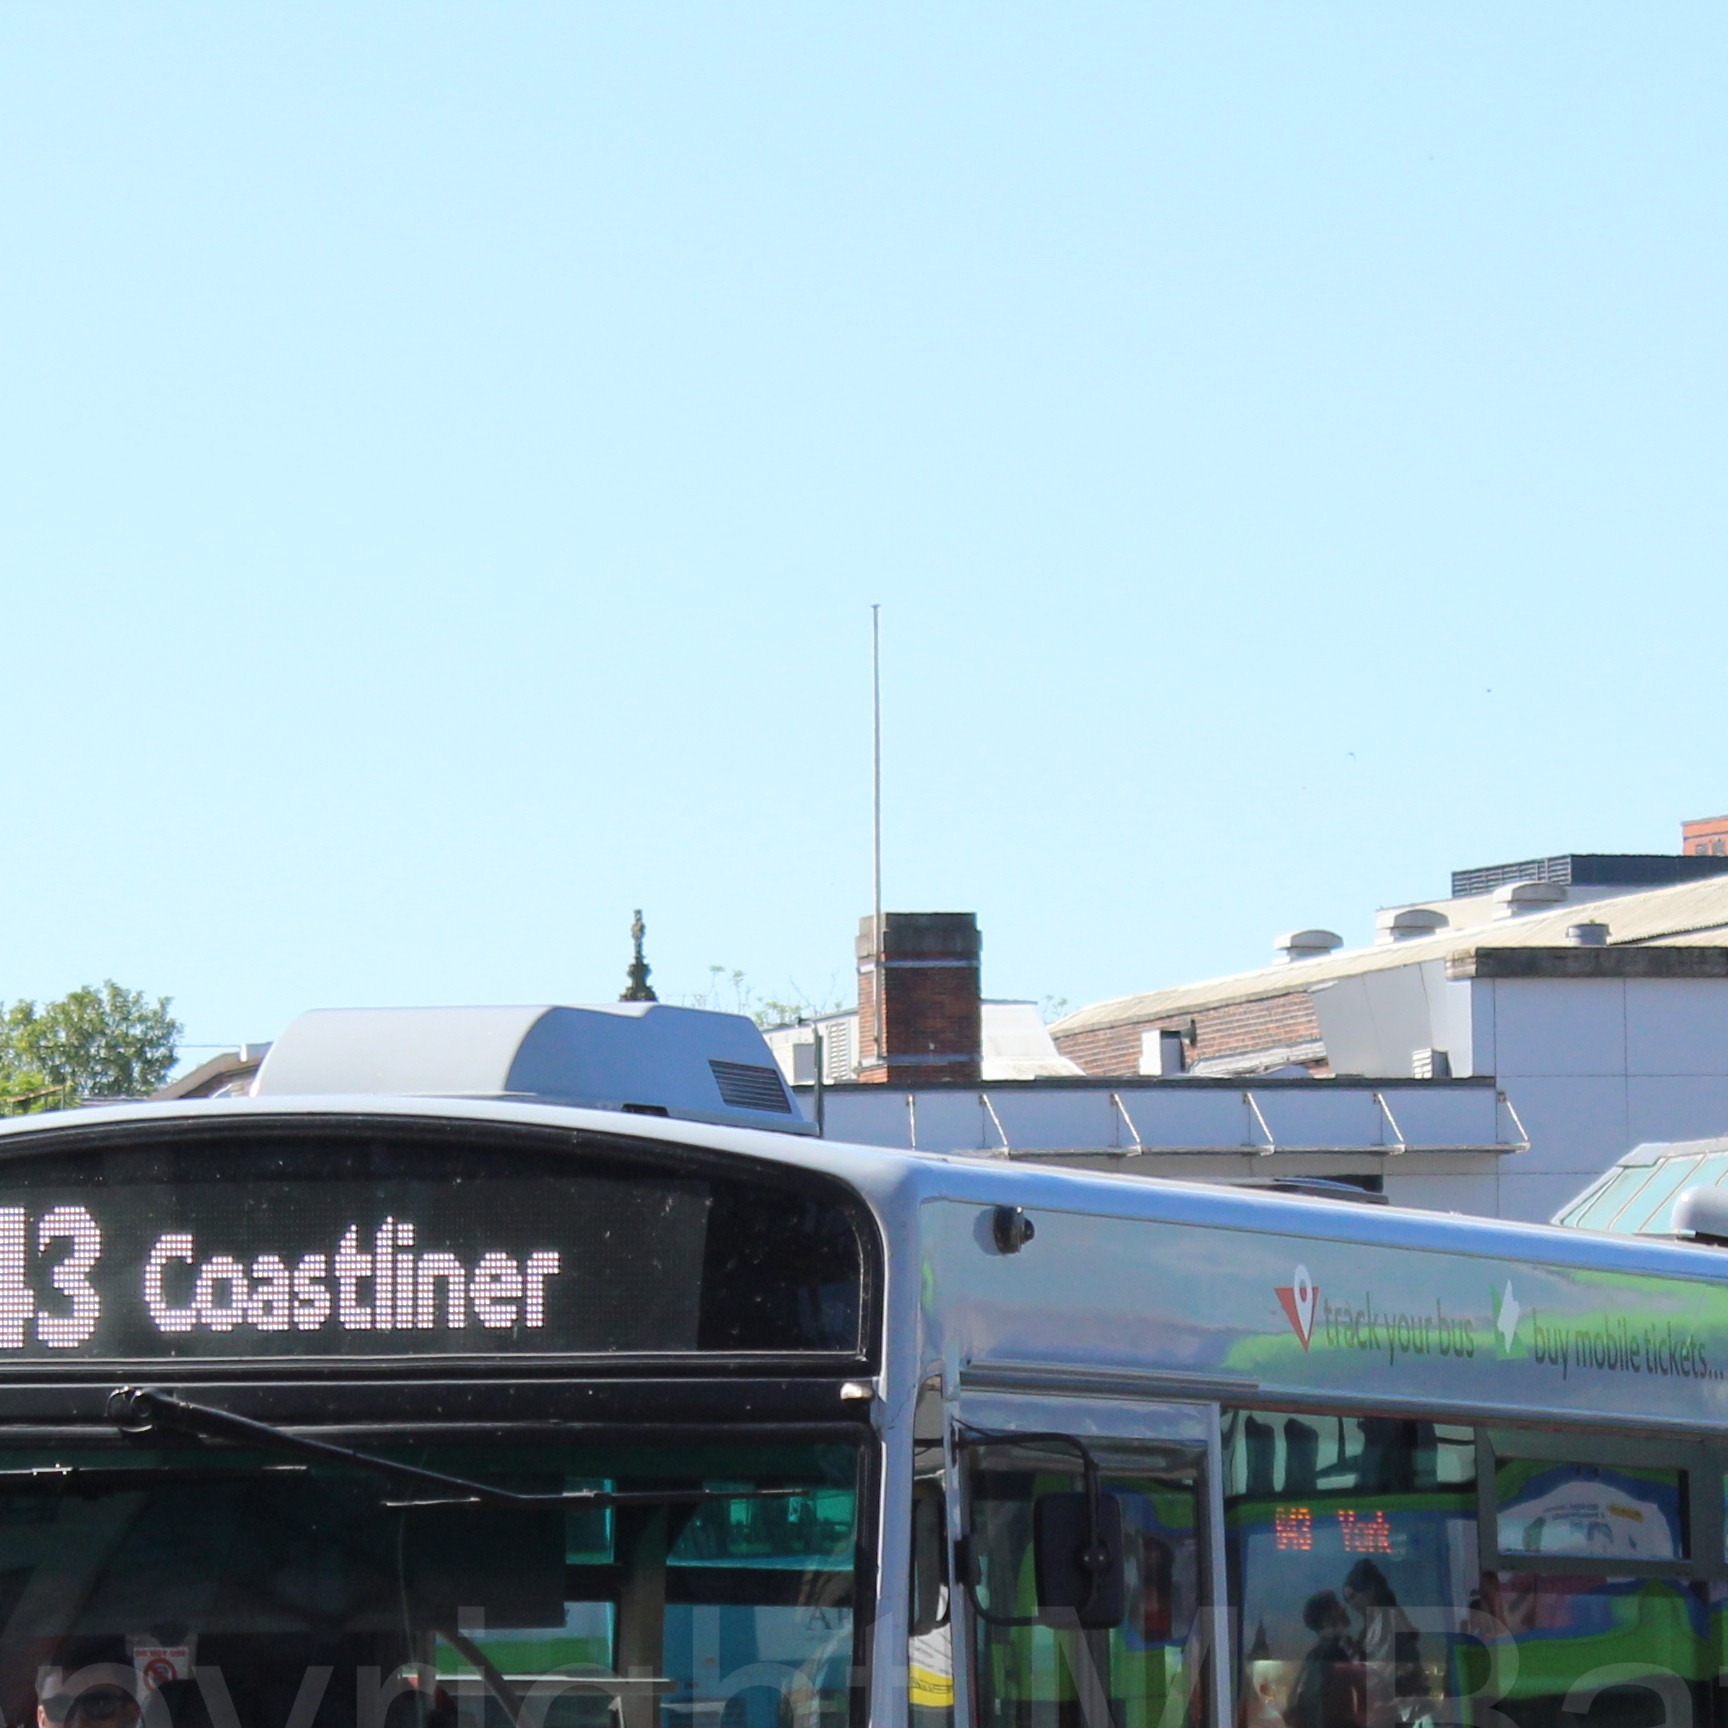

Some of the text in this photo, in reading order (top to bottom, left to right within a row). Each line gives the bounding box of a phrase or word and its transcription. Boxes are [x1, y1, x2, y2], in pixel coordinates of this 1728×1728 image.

[143, 1215, 561, 1332] Coastliner
[1323, 1290, 1474, 1367] track your bus
[1531, 1306, 1570, 1381] buy
[1574, 1315, 1641, 1373] mobile
